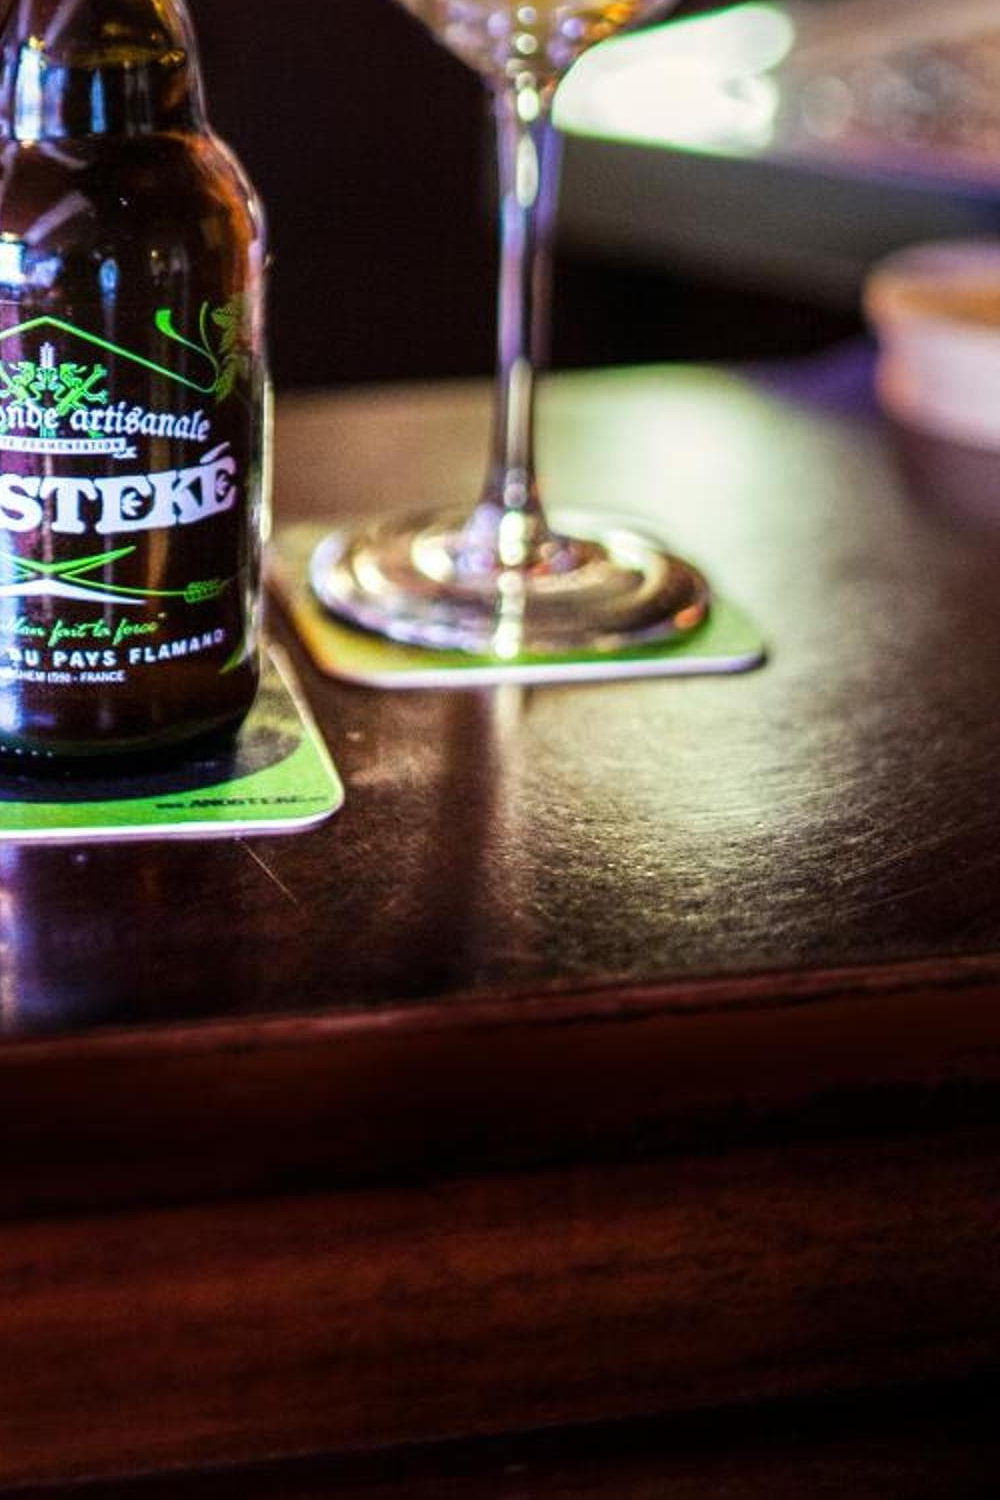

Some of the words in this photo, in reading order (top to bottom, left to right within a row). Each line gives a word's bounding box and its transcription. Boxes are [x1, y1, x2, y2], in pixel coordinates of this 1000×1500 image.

[70, 402, 210, 441] artisanale
[53, 650, 118, 668] PAYS
[130, 628, 226, 665] FLAMAND
[79, 670, 126, 683] FRANCE
